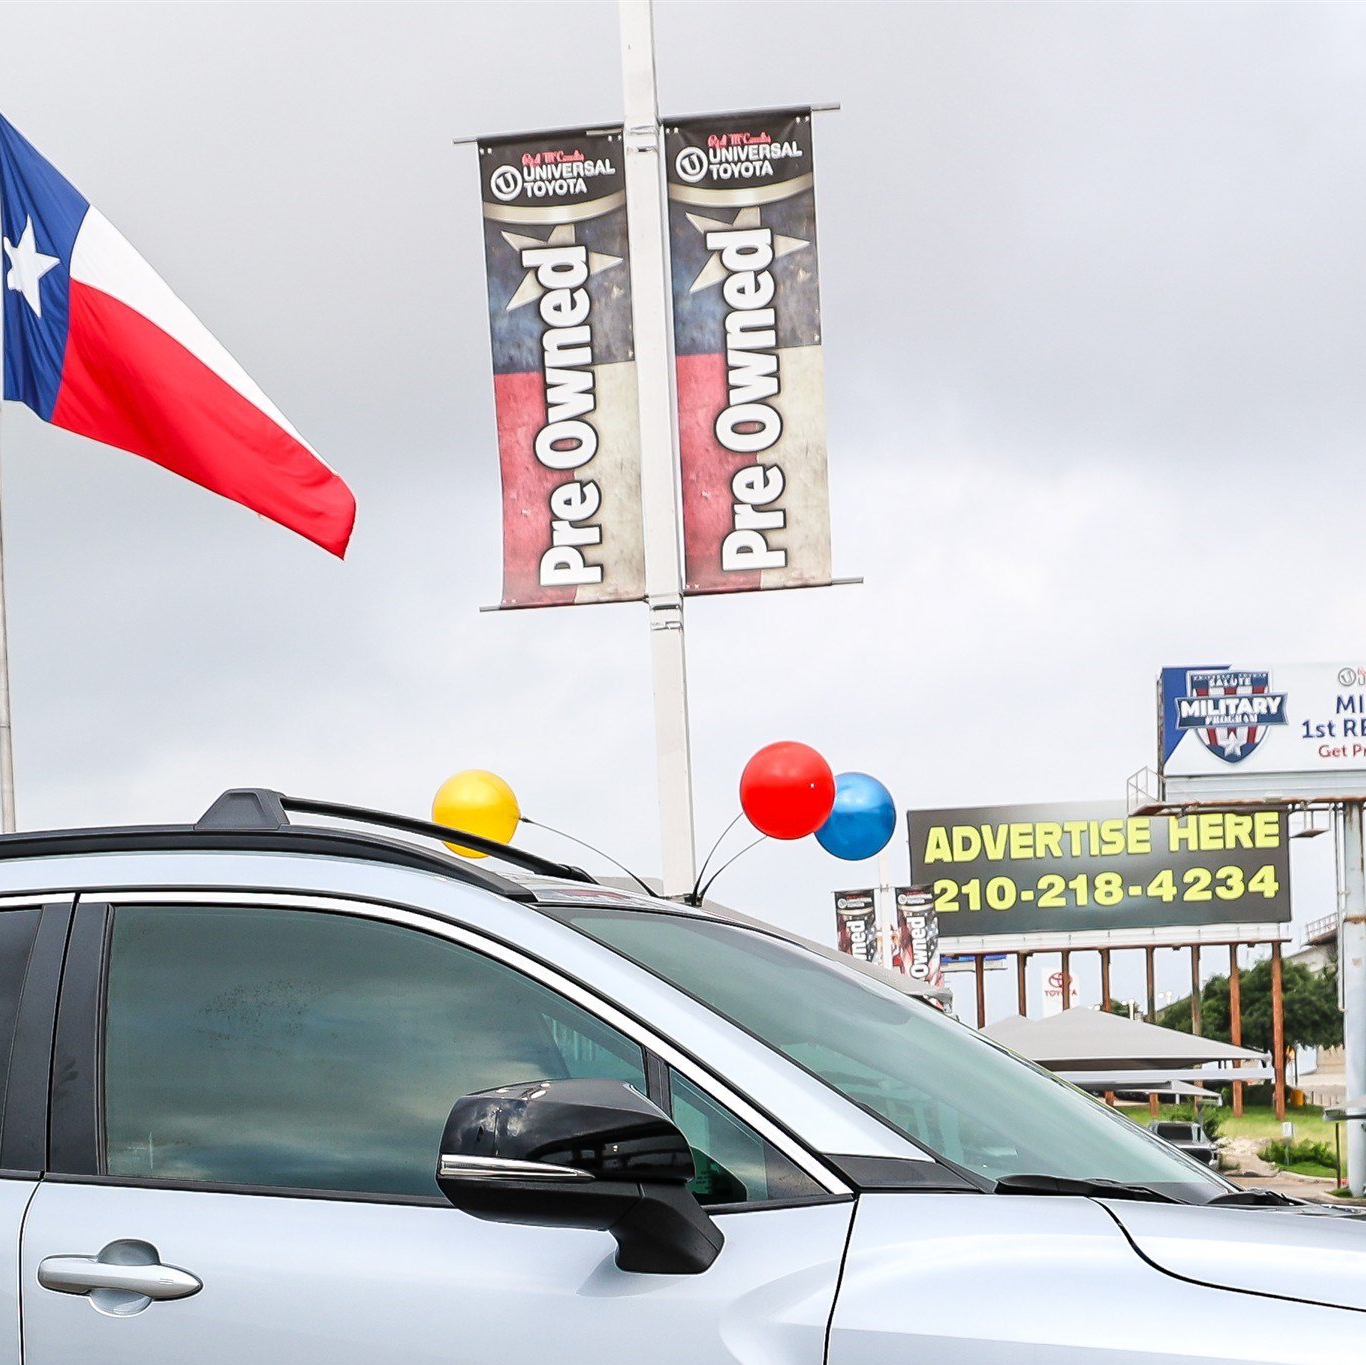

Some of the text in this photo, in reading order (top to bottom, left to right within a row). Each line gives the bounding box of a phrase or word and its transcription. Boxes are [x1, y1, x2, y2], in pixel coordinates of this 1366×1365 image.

[708, 141, 803, 163] UNIVERSAL
[522, 159, 616, 182] UNIVERSAL
[709, 160, 774, 180] TOYOTA
[523, 178, 587, 198] TOYOTA
[706, 227, 788, 571] Pre Owned
[521, 245, 603, 586] Pre Owned
[1180, 696, 1282, 718] MILITARY
[1301, 720, 1336, 739] 1st
[1318, 744, 1347, 759] Get
[924, 811, 1280, 864] ADVERTISE HERE
[933, 864, 1280, 913] 210-218-4234
[845, 919, 867, 960] ned
[906, 916, 930, 979] Owned
